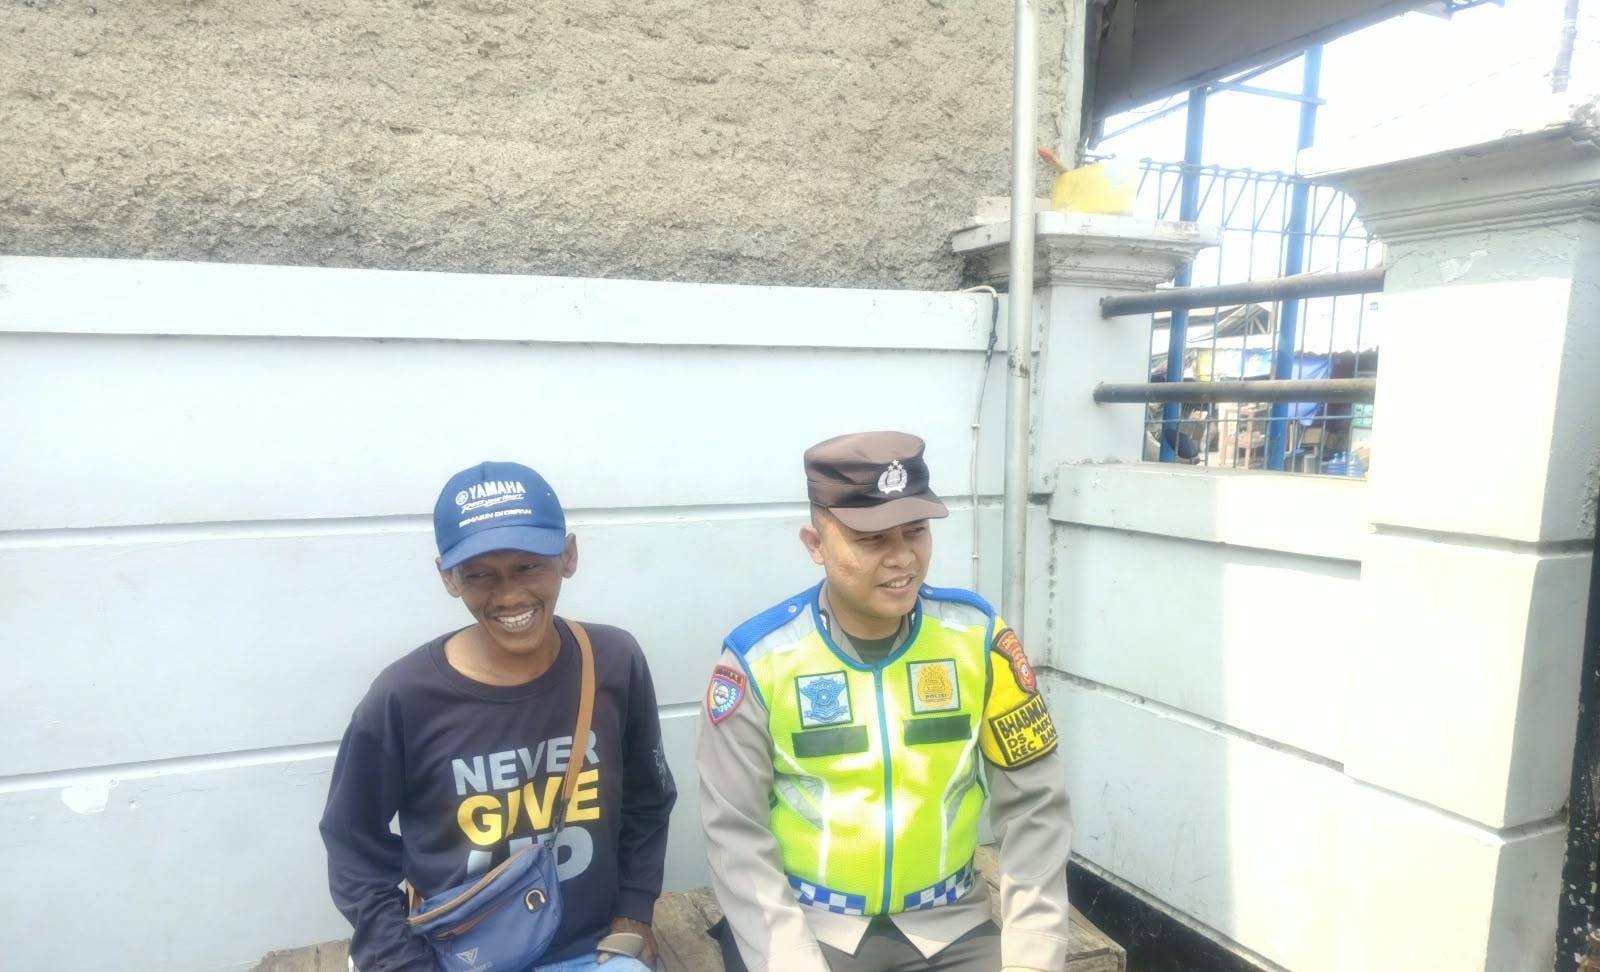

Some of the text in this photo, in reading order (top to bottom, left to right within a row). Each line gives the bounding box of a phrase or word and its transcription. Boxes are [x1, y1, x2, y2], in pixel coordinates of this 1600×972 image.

[469, 481, 526, 500] YAMAHA
[1011, 741, 1036, 760] KEC
[457, 769, 600, 846] GIVE
